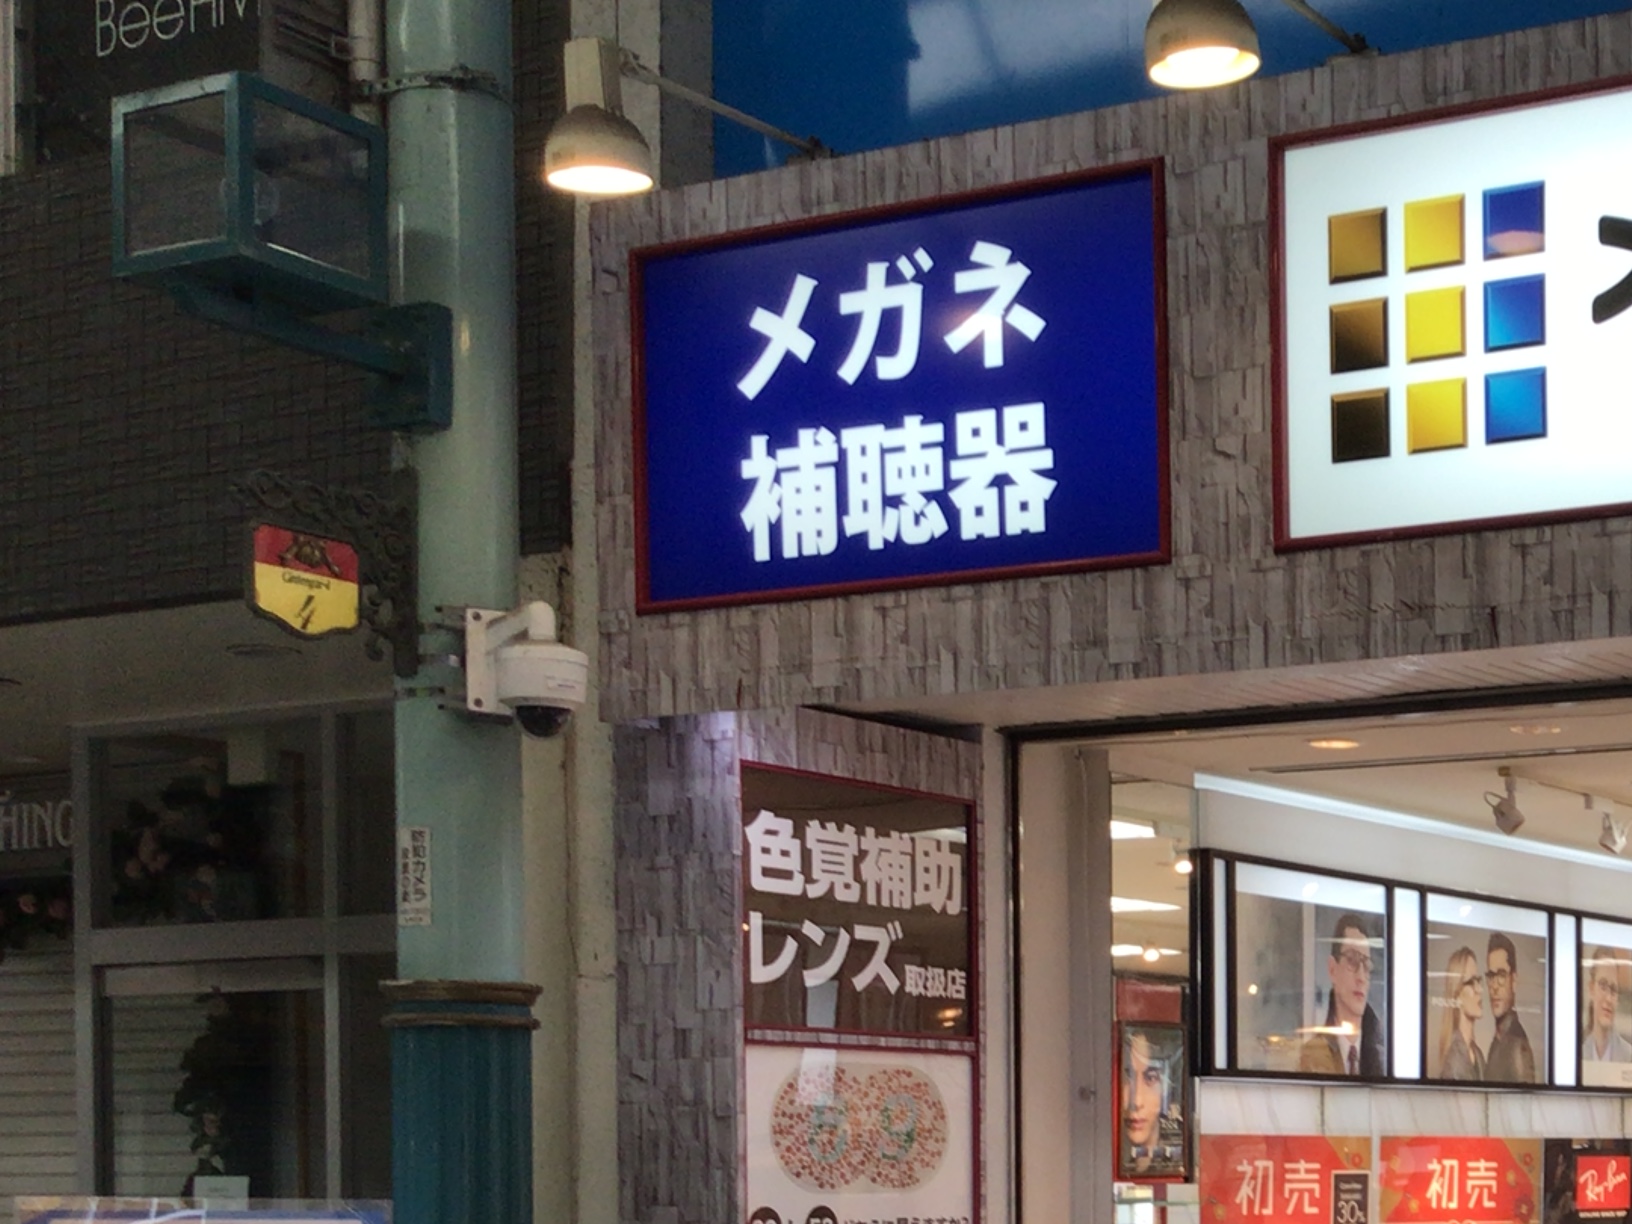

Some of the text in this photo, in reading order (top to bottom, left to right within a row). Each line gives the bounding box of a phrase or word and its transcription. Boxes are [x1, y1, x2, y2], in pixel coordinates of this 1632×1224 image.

[736, 240, 1047, 401] メガネ
[741, 402, 1057, 562] 補聴器
[745, 810, 962, 916] 色覚補助
[748, 911, 967, 999] レンズ 取扱店
[1235, 1158, 1321, 1215] 初売
[1426, 1158, 1498, 1210] 初売
